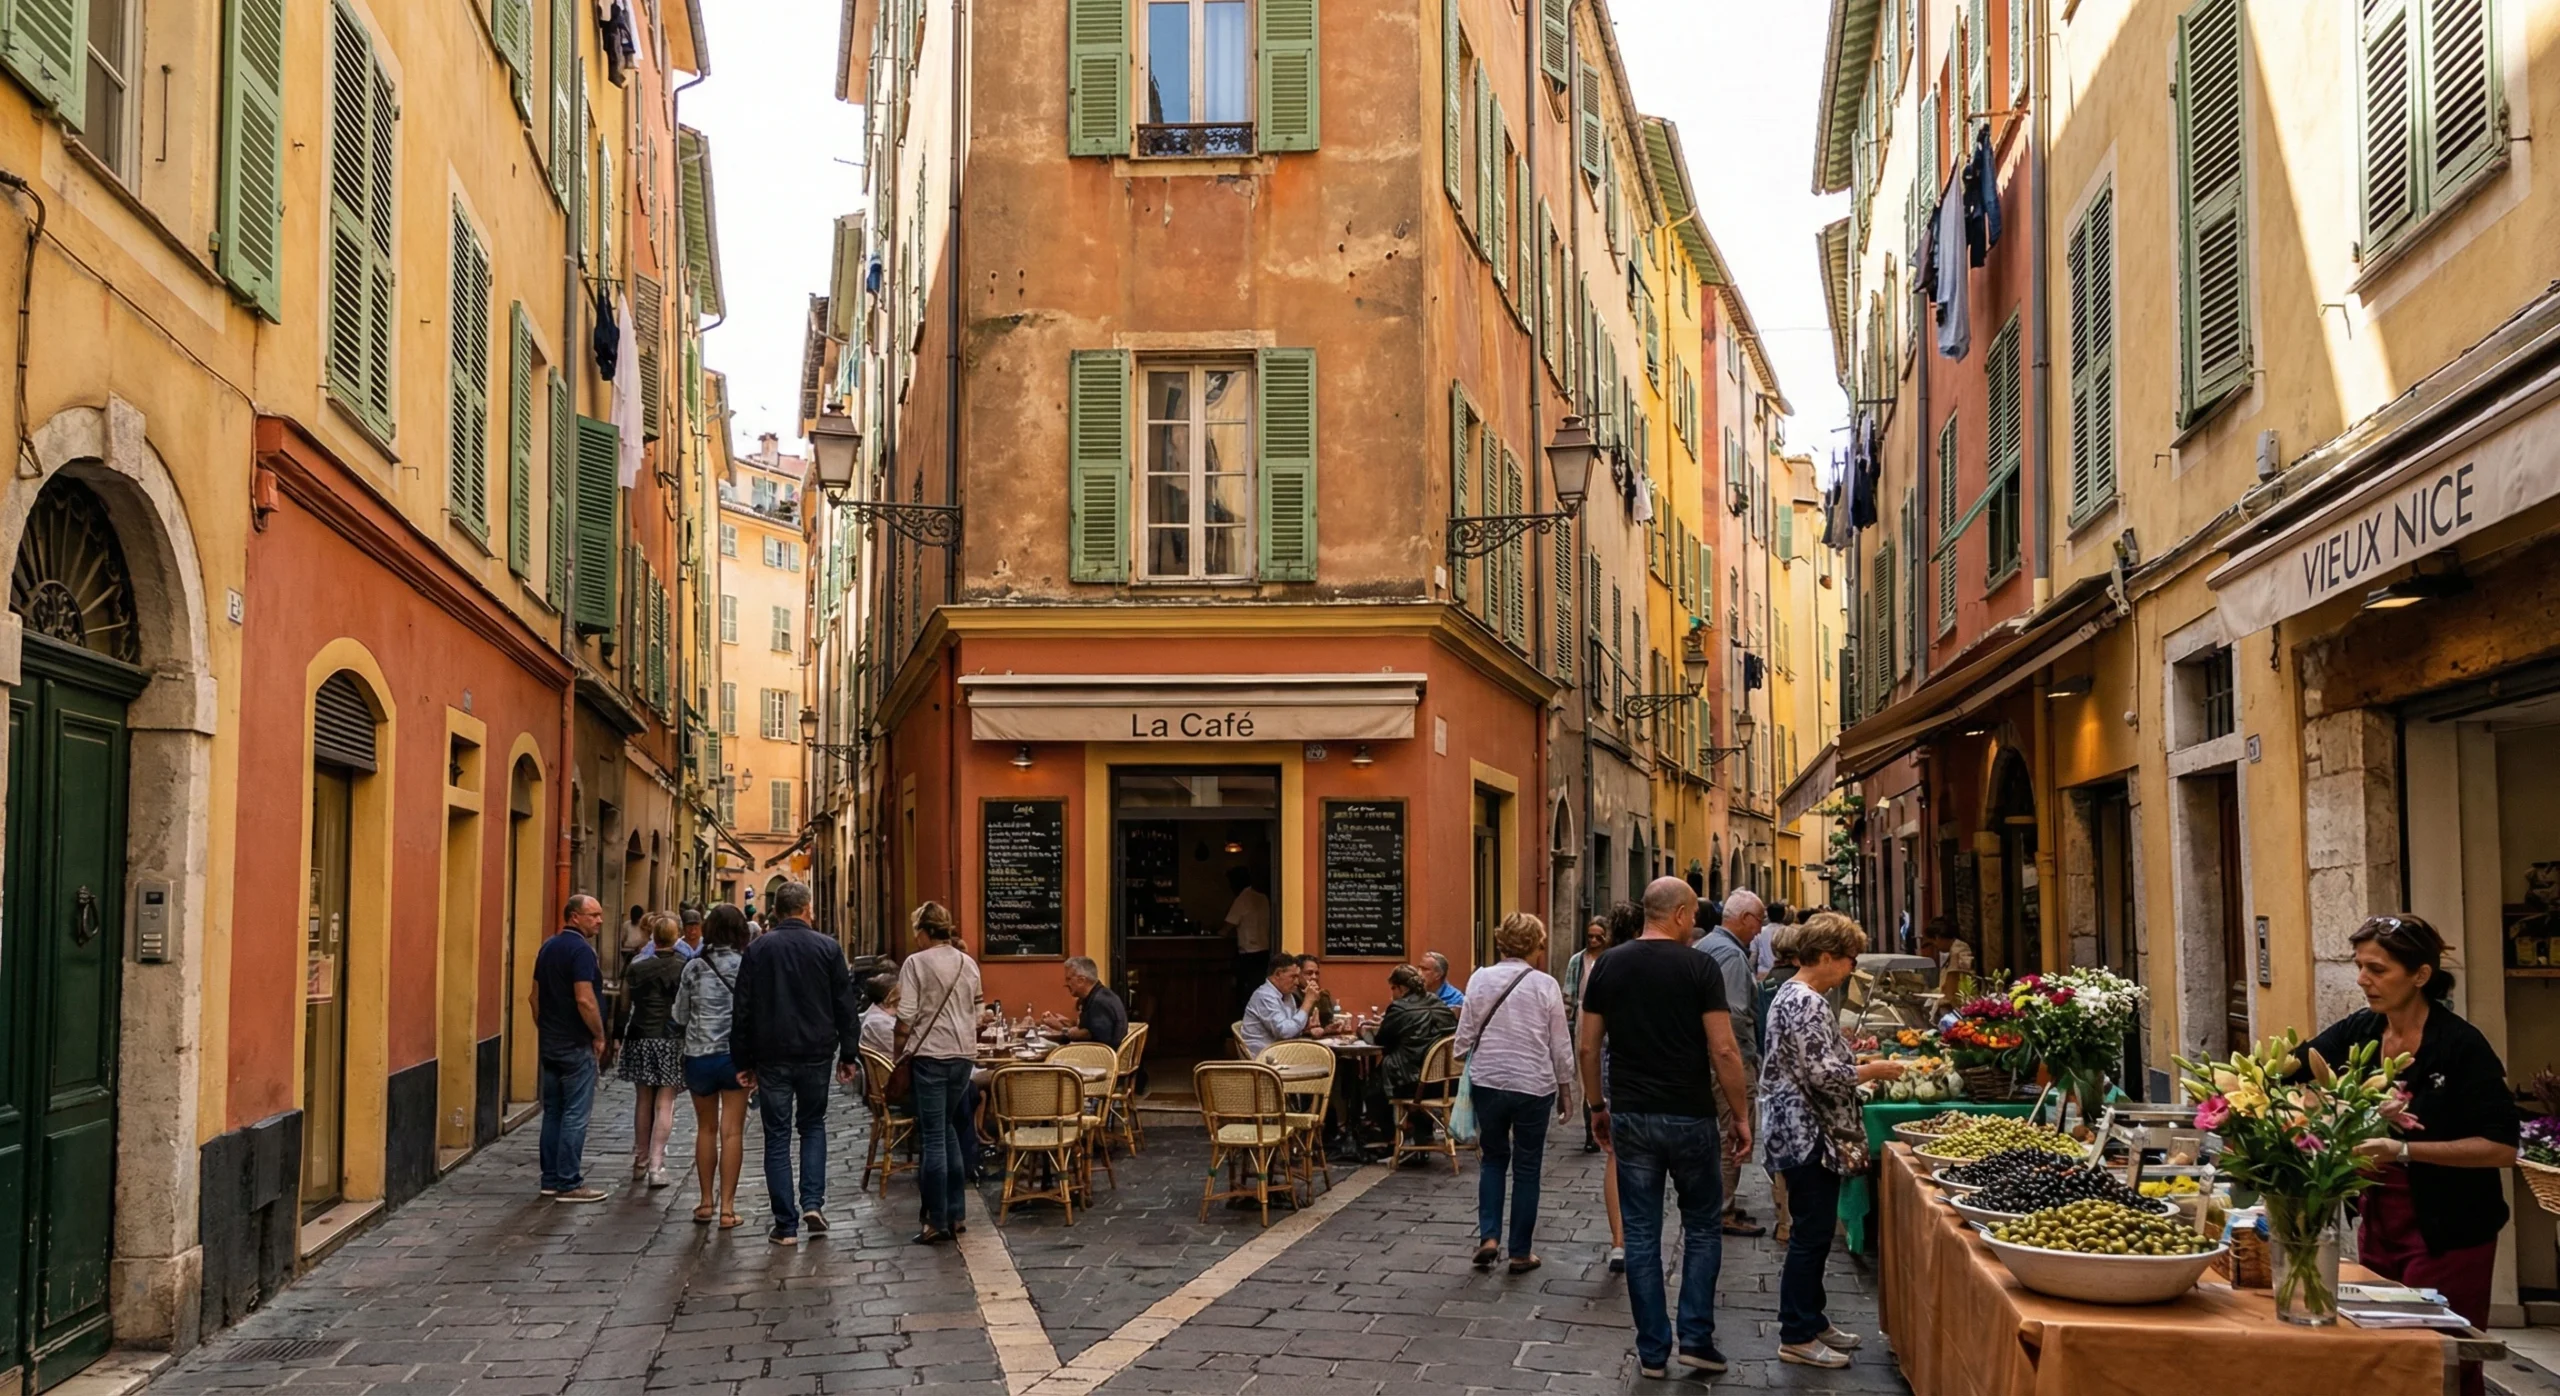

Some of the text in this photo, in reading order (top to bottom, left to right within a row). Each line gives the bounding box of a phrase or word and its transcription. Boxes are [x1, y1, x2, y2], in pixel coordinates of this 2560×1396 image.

[2303, 462, 2474, 599] VIEUX NICE
[1132, 711, 1254, 738] La Café
